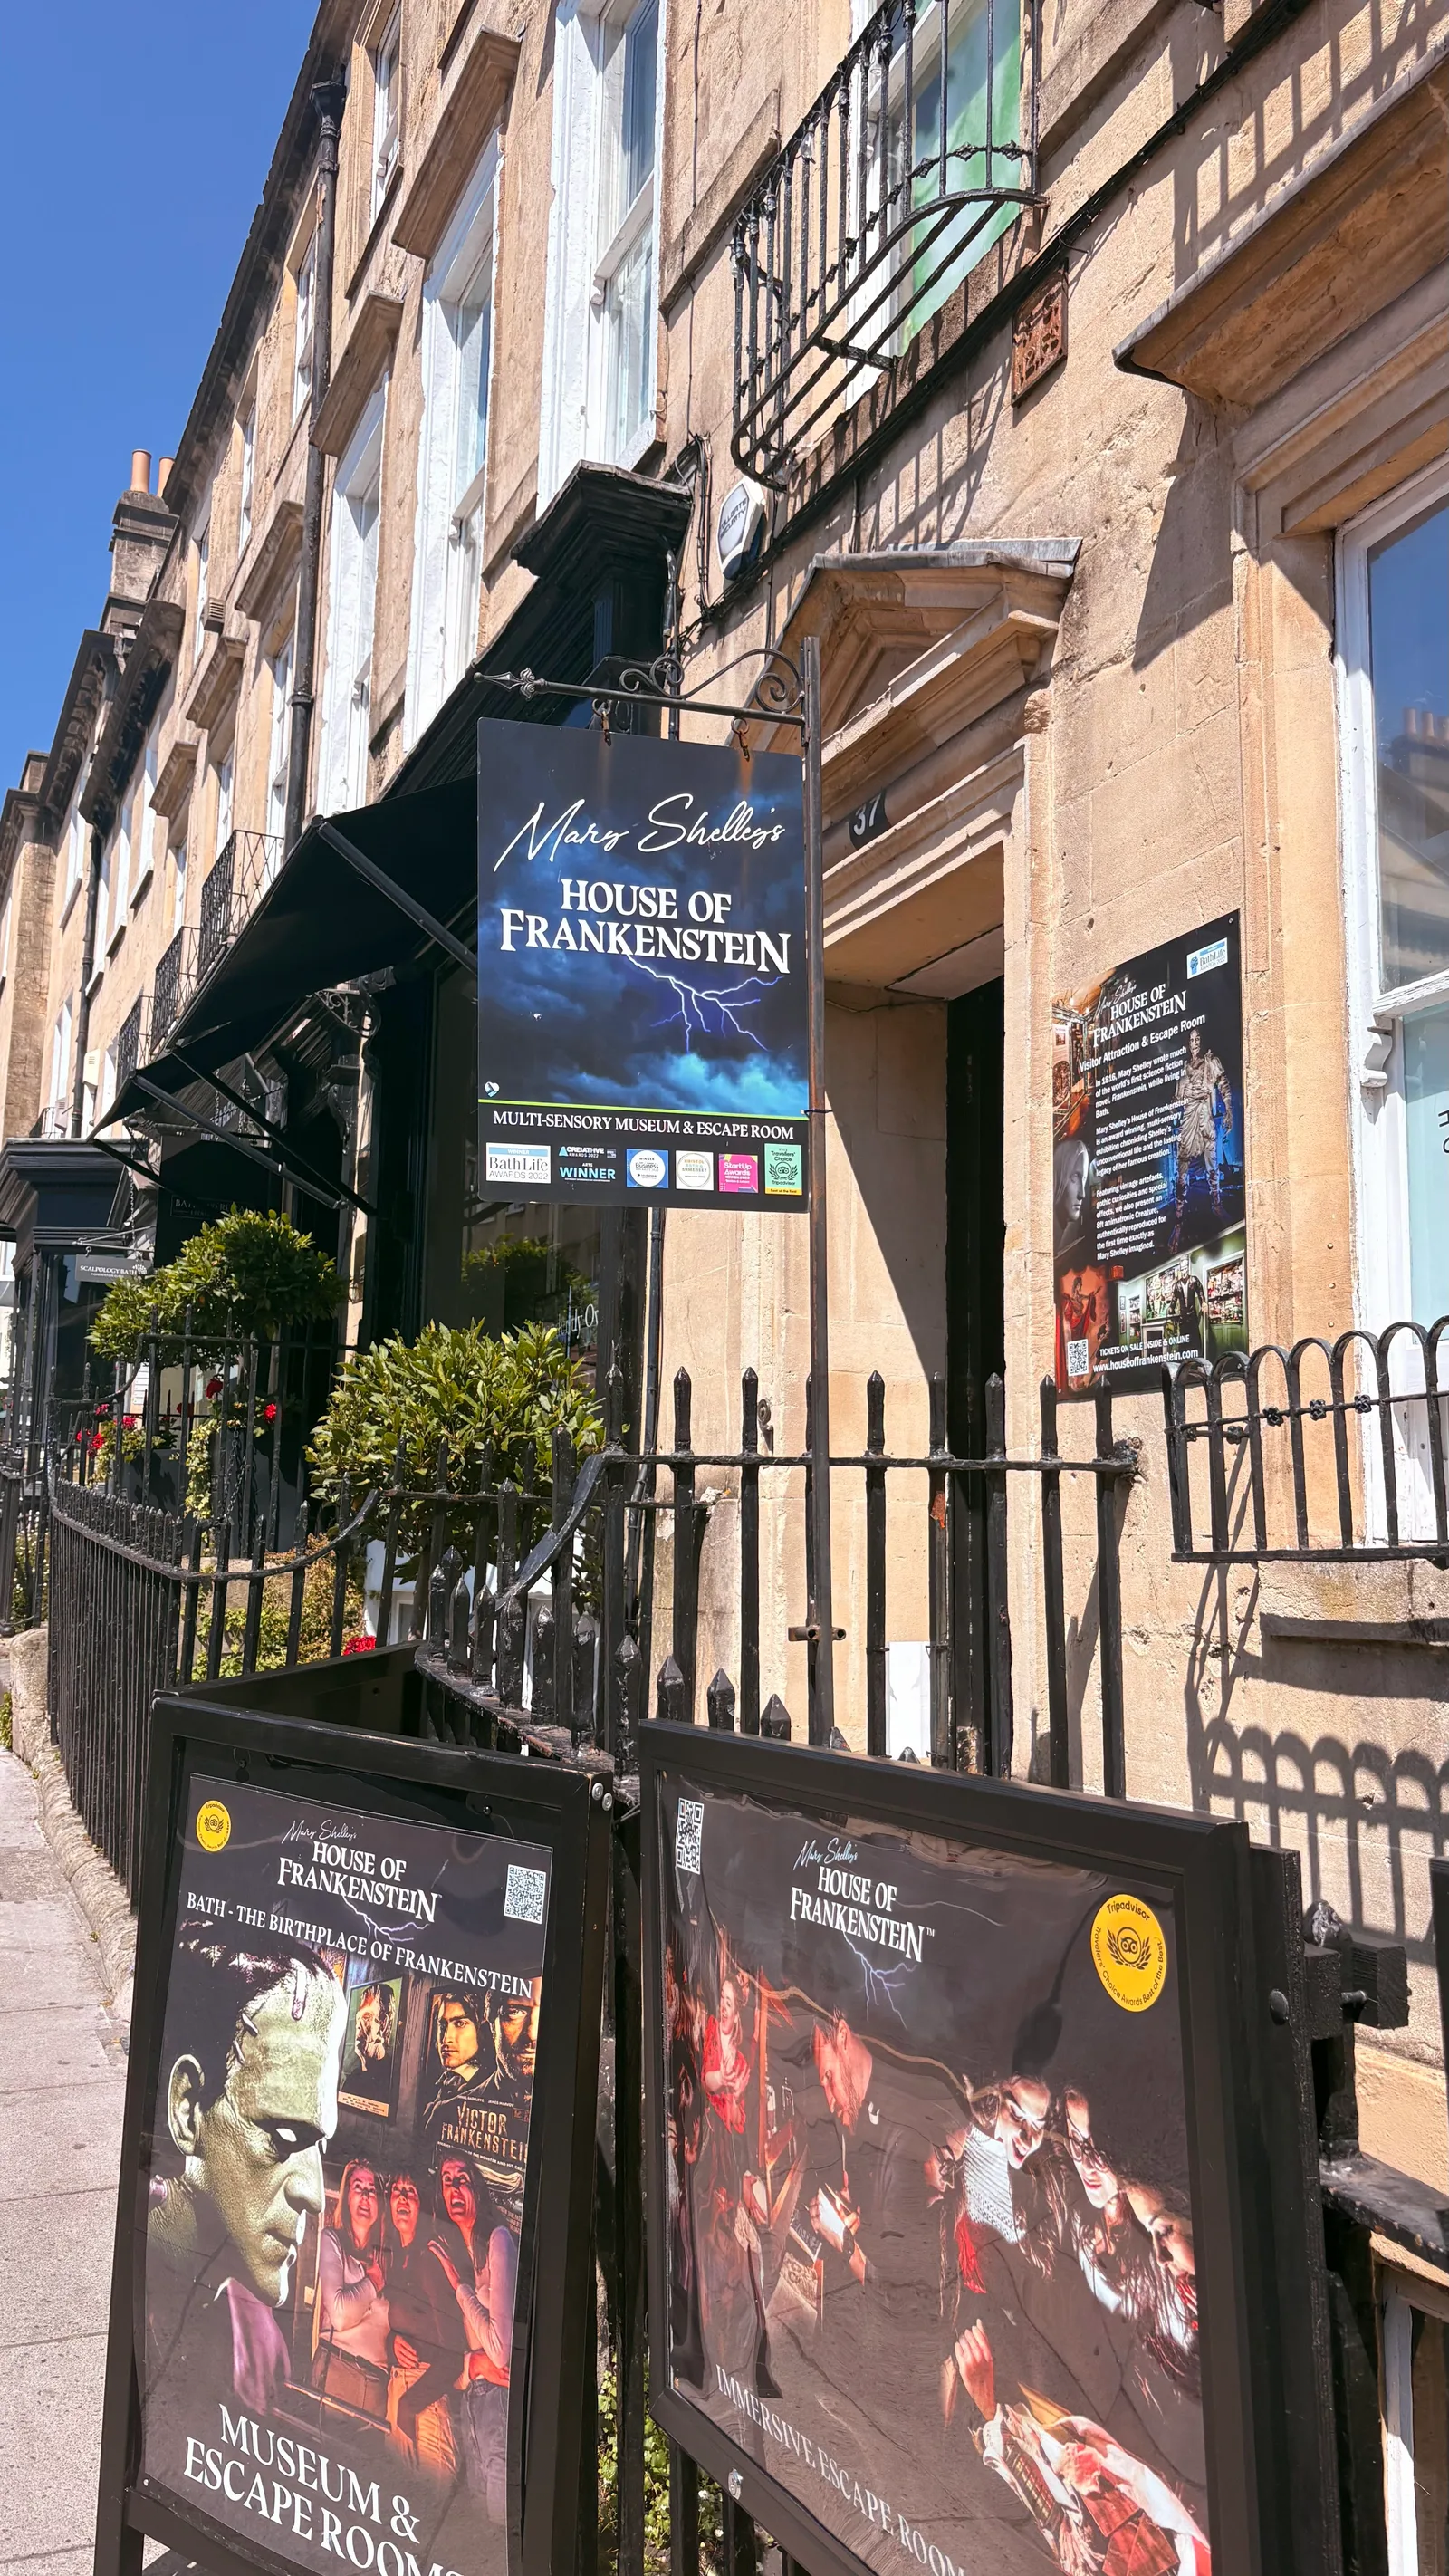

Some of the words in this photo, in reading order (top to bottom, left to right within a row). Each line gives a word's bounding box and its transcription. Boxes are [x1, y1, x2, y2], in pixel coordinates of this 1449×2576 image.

[853, 793, 881, 835] 37
[494, 798, 629, 872] Mary
[637, 793, 785, 853] Shelley's
[560, 878, 677, 920] HOUSE
[687, 890, 732, 924] OF
[500, 908, 792, 974] FRANKENSTEIN
[1110, 992, 1147, 1020] HOUSE
[1150, 984, 1166, 1003] OF
[1093, 990, 1186, 1048] FRANKENSTEIN
[1080, 1055, 1101, 1072] Visitor
[1103, 1042, 1139, 1062] Attraction
[1142, 1037, 1148, 1047] &
[1150, 1026, 1178, 1043] Escape
[1181, 1015, 1205, 1032] Room
[1118, 1068, 1132, 1078] Mary
[1132, 1061, 1152, 1074] Shelley
[1153, 1054, 1168, 1064] wrote
[1170, 1047, 1186, 1061] much
[1096, 1089, 1101, 1097] of
[1102, 1087, 1110, 1095] the
[1131, 1074, 1142, 1083] first
[1143, 1067, 1164, 1080] science
[1165, 1060, 1183, 1072] fiction
[1148, 1078, 1163, 1088] while
[1164, 1071, 1180, 1082] living
[493, 1110, 612, 1131] MULTI-SENSORY
[615, 1115, 680, 1135] MUSEUM
[683, 1120, 695, 1135] &
[696, 1121, 749, 1138] ESCAPE
[751, 1124, 794, 1139] ROOM
[1096, 1126, 1108, 1134] Mary
[1109, 1118, 1130, 1130] Shelley's
[1131, 1112, 1147, 1122] House
[1148, 1109, 1154, 1117] of
[1155, 1098, 1188, 1114] Frankenstein
[1096, 1144, 1119, 1156] exhibition
[1148, 1126, 1171, 1140] Shelley's
[1108, 1129, 1124, 1141] award
[1134, 1146, 1142, 1154] life
[1143, 1142, 1153, 1151] and
[489, 1157, 521, 1171] Bath
[523, 1158, 548, 1172] Life
[489, 1170, 526, 1179] AWARDS
[528, 1171, 549, 1180] 2022
[560, 1167, 616, 1179] WINNER
[1096, 1168, 1111, 1177] legacy
[1112, 1163, 1118, 1171] of
[1128, 1156, 1147, 1167] famous
[1096, 1186, 1119, 1197] Featuring
[1120, 1180, 1138, 1190] vintage
[1096, 1198, 1111, 1209] gothic
[1138, 1187, 1147, 1196] and
[1149, 1181, 1167, 1193] special
[1135, 1197, 1154, 1209] present
[1097, 1226, 1128, 1239] authentically
[1128, 1217, 1157, 1231] reproduced
[1105, 1213, 1134, 1226] animatronic
[1106, 1239, 1116, 1247] first
[1129, 1232, 1147, 1242] exactly
[1110, 1248, 1128, 1257] Shelley
[1099, 1346, 1119, 1356] TICKETS
[1121, 1344, 1129, 1353] ON
[1129, 1342, 1143, 1351] SALE
[1144, 1339, 1162, 1349] INSIDE
[1163, 1339, 1168, 1347] &
[1168, 1334, 1190, 1345] ONLINE
[1093, 1350, 1198, 1372] www.houseoffrankenstein.com
[282, 1820, 317, 1844] Mary
[312, 1841, 376, 1875] HOUSE
[380, 1857, 407, 1882] OF
[793, 1840, 823, 1870] Mary
[824, 1838, 858, 1864] Shelley's
[277, 1857, 439, 1923] FRANKENSTEIN
[817, 1866, 871, 1905] HOUSE
[875, 1882, 897, 1912] OF
[1107, 1901, 1150, 1920] Tripadvisor
[187, 1892, 226, 1918] BATH
[236, 1904, 267, 1929] THE
[270, 1914, 368, 1956] BIRTHPLACE
[370, 1940, 393, 1962] OF
[395, 1946, 533, 1999] FRANKENSTEIN
[1102, 1970, 1121, 1999] Choice
[1121, 1994, 1143, 2006] Awards
[1142, 1988, 1155, 2003] Best
[1154, 1979, 1159, 1990] of
[457, 2101, 507, 2136] VICTOR
[441, 2122, 528, 2163] FRANKENSTEI
[715, 2364, 817, 2468] IMMERSIVE
[818, 2447, 894, 2536] ESCAPE
[218, 2403, 383, 2525] MUSEUM
[389, 2494, 421, 2544] &
[183, 2437, 313, 2538] ESCAPE
[321, 2507, 465, 2576] ROO
